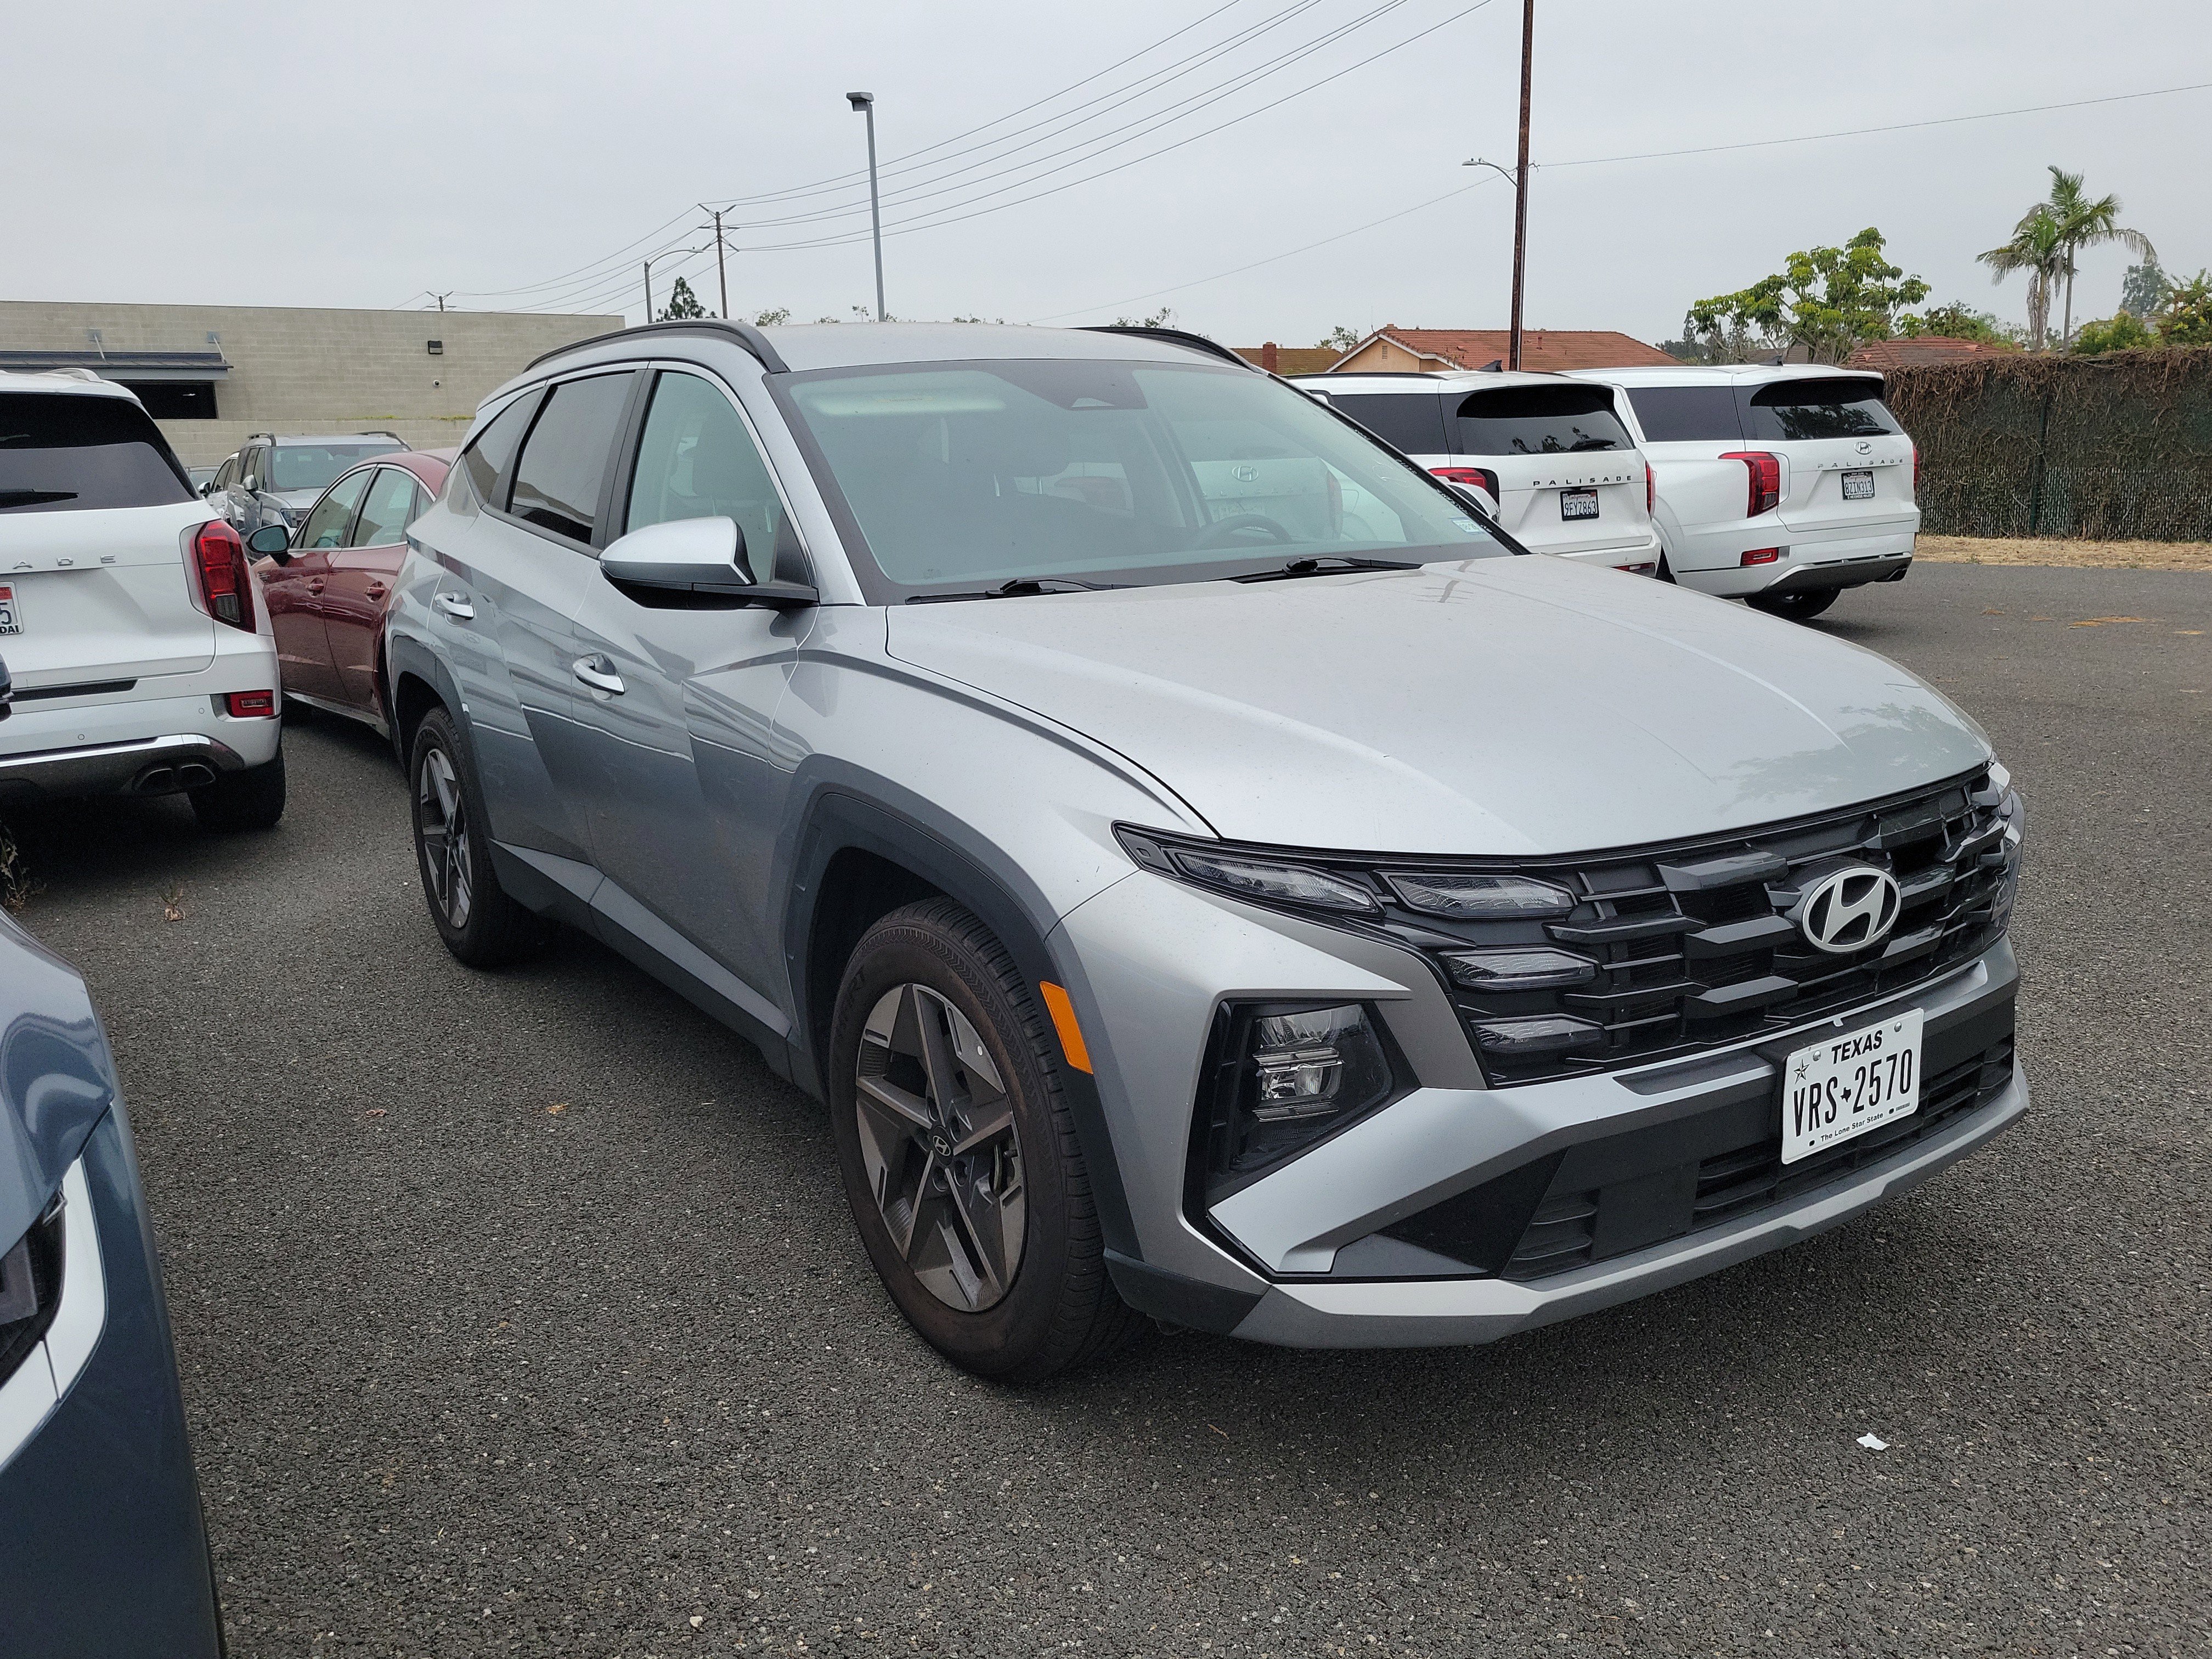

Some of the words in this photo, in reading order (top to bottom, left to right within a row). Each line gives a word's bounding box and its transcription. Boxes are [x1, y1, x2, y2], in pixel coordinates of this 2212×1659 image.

[1818, 459, 1903, 469] PALISADE
[1533, 475, 1632, 487] PALISADE
[1844, 480, 1872, 494] 8ZIN313
[1565, 500, 1596, 516] 9FYZ863
[1831, 1030, 1883, 1065] TEXAS
[1793, 1076, 1838, 1137] VRS
[1852, 1048, 1912, 1114] 2570
[1820, 1133, 1833, 1142] The
[1834, 1126, 1850, 1137] Lone
[1852, 1120, 1865, 1130] Star
[1866, 1113, 1883, 1124] State
